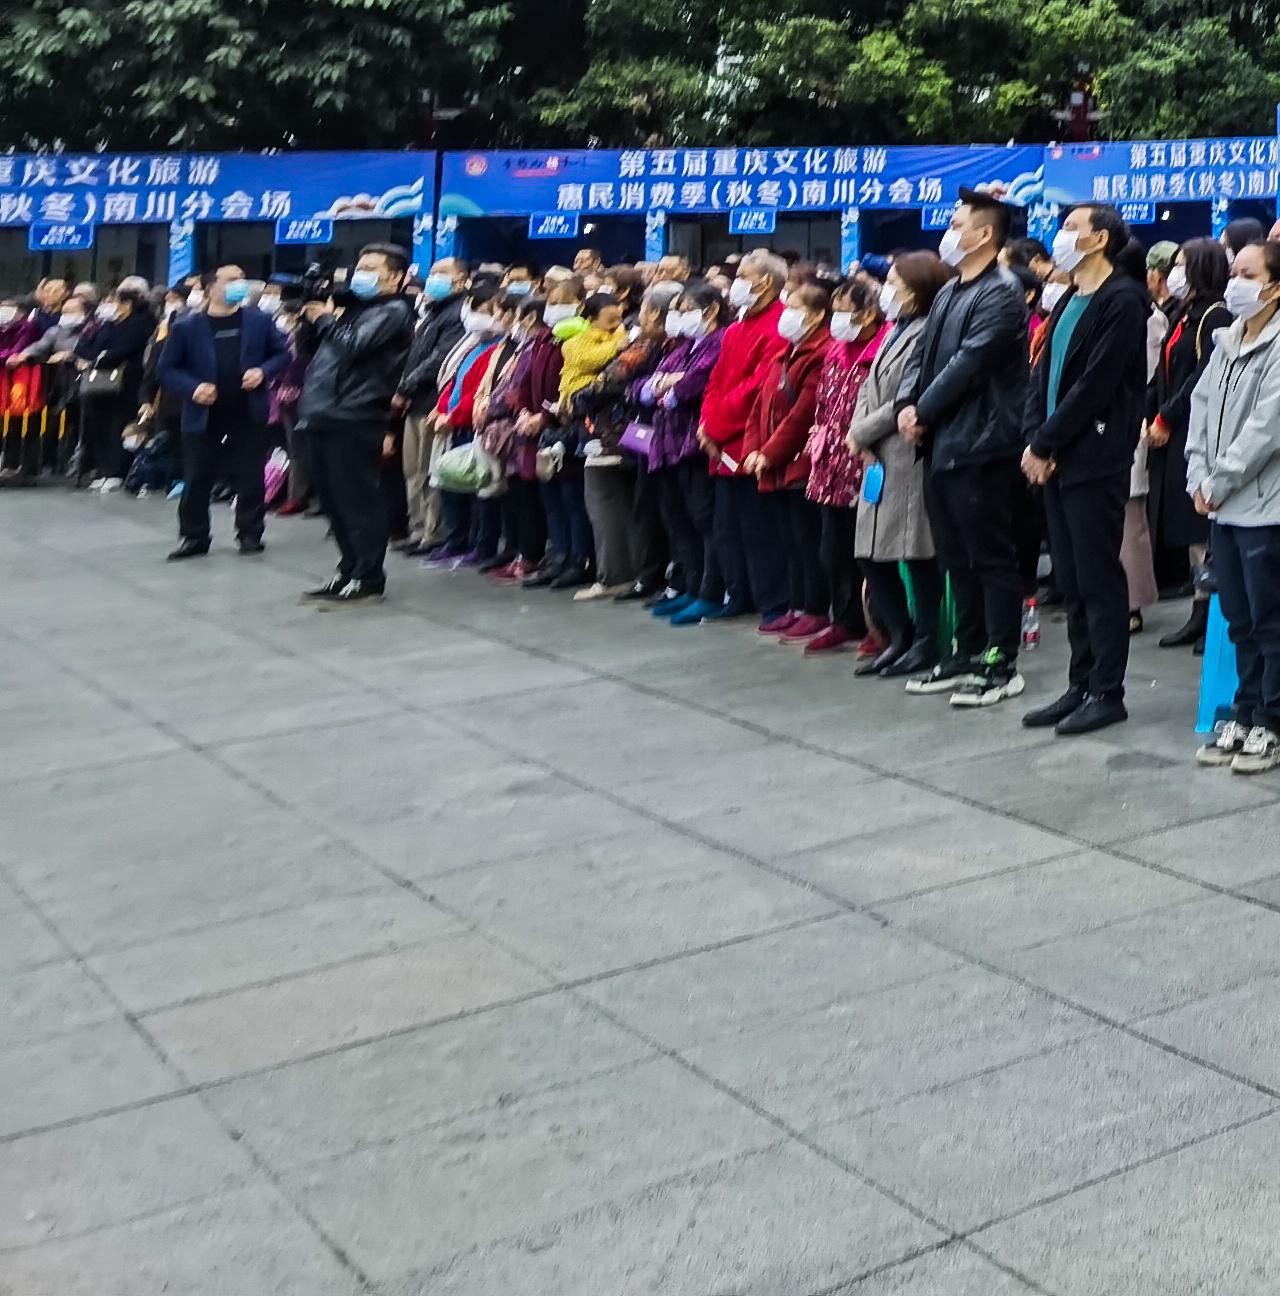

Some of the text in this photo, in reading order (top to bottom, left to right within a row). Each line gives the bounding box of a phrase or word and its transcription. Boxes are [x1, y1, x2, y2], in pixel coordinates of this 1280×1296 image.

[618, 147, 888, 178] 第五届重庆文化旅游
